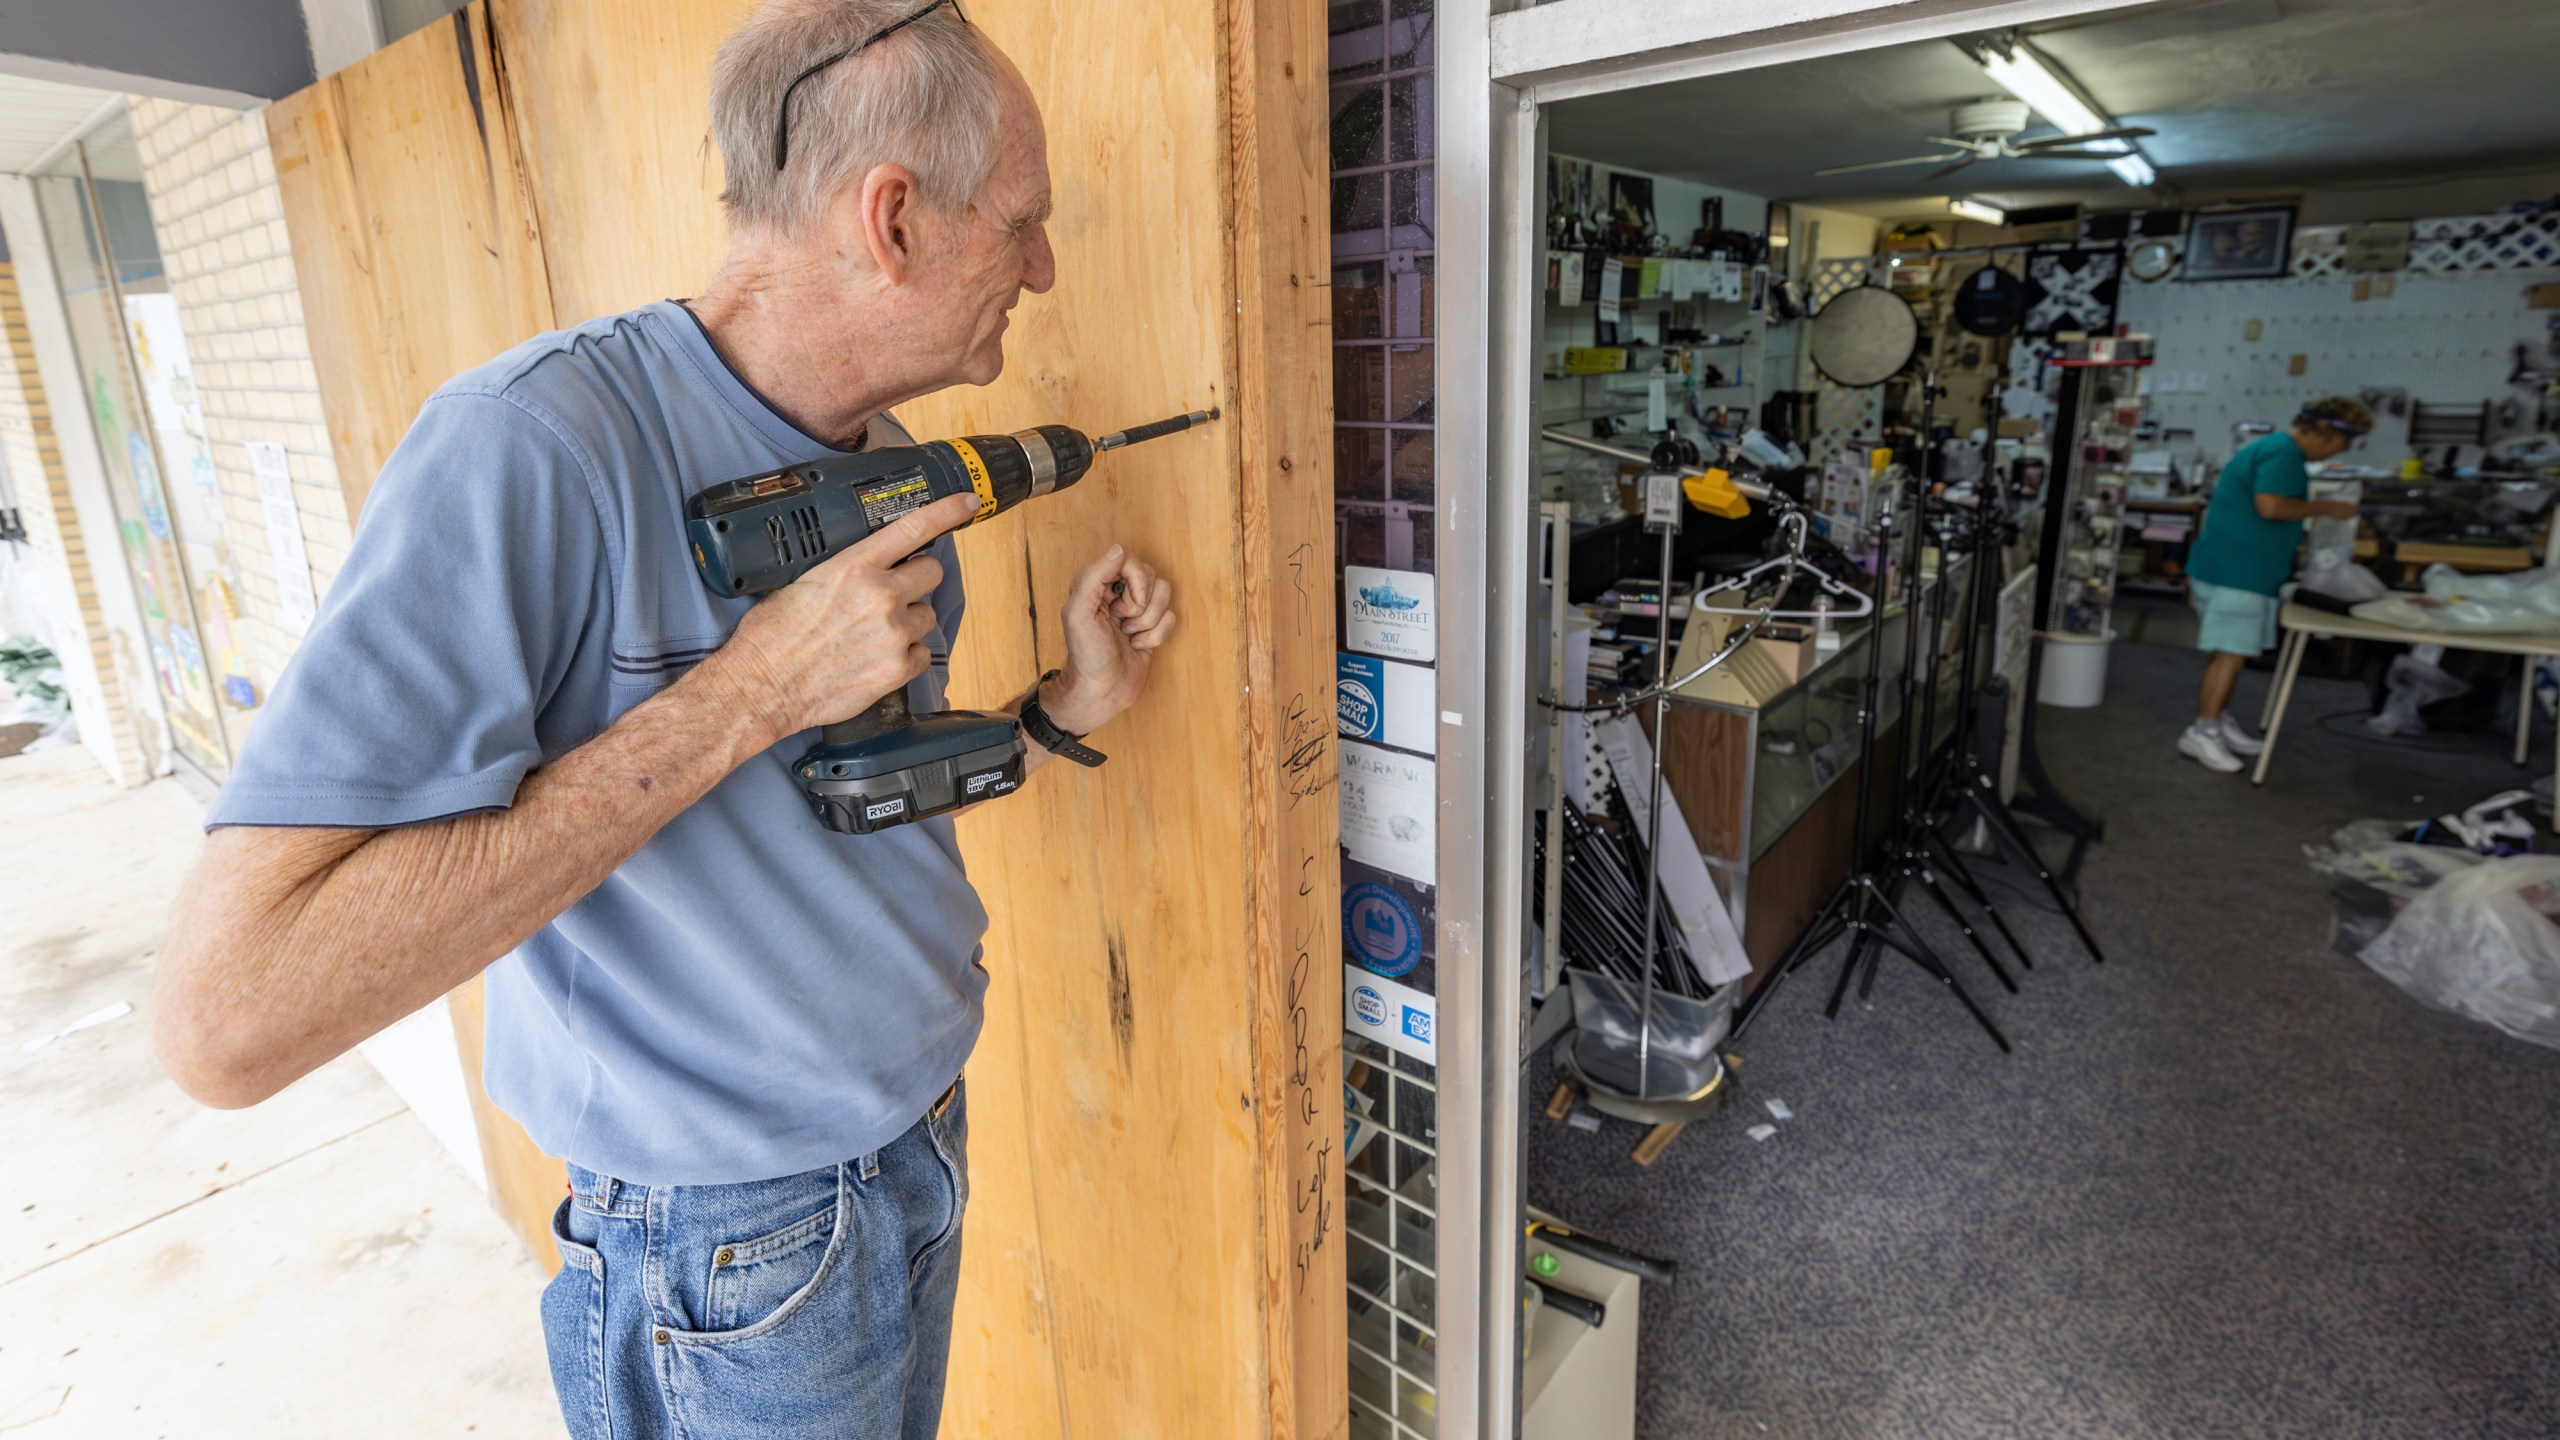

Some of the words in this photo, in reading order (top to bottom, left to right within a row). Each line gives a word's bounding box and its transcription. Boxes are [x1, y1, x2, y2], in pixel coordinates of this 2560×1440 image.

[969, 466, 982, 481] 20
[1380, 631, 1400, 644] 2017
[1339, 694, 1368, 714] SHOP
[1337, 702, 1368, 727] SMALL
[968, 772, 1001, 785] Lithium
[968, 783, 984, 793] 18V
[869, 801, 902, 817] RYOBI
[1357, 1002, 1382, 1017] SMALL
[1359, 996, 1380, 1009] SHOP
[1410, 1014, 1431, 1029] AM
[1412, 1025, 1431, 1039] EX
